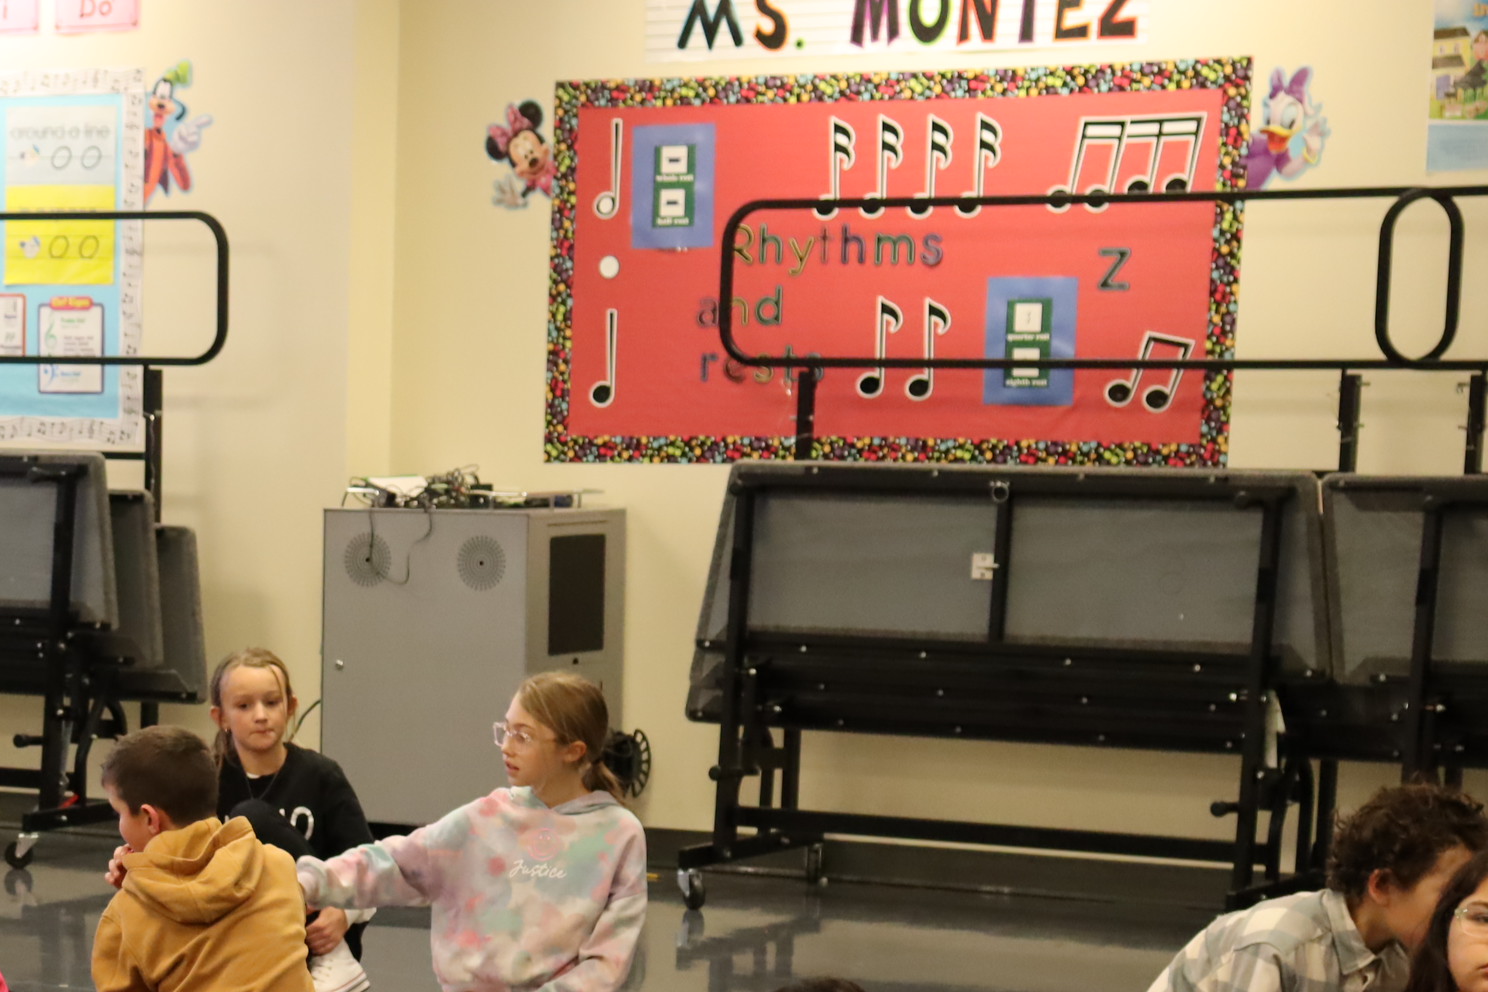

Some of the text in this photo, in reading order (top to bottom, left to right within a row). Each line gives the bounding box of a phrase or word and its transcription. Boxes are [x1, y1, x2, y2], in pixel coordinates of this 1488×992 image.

[734, 223, 944, 277] Rhythms
[696, 284, 783, 327] and
[509, 859, 567, 879] Justice
